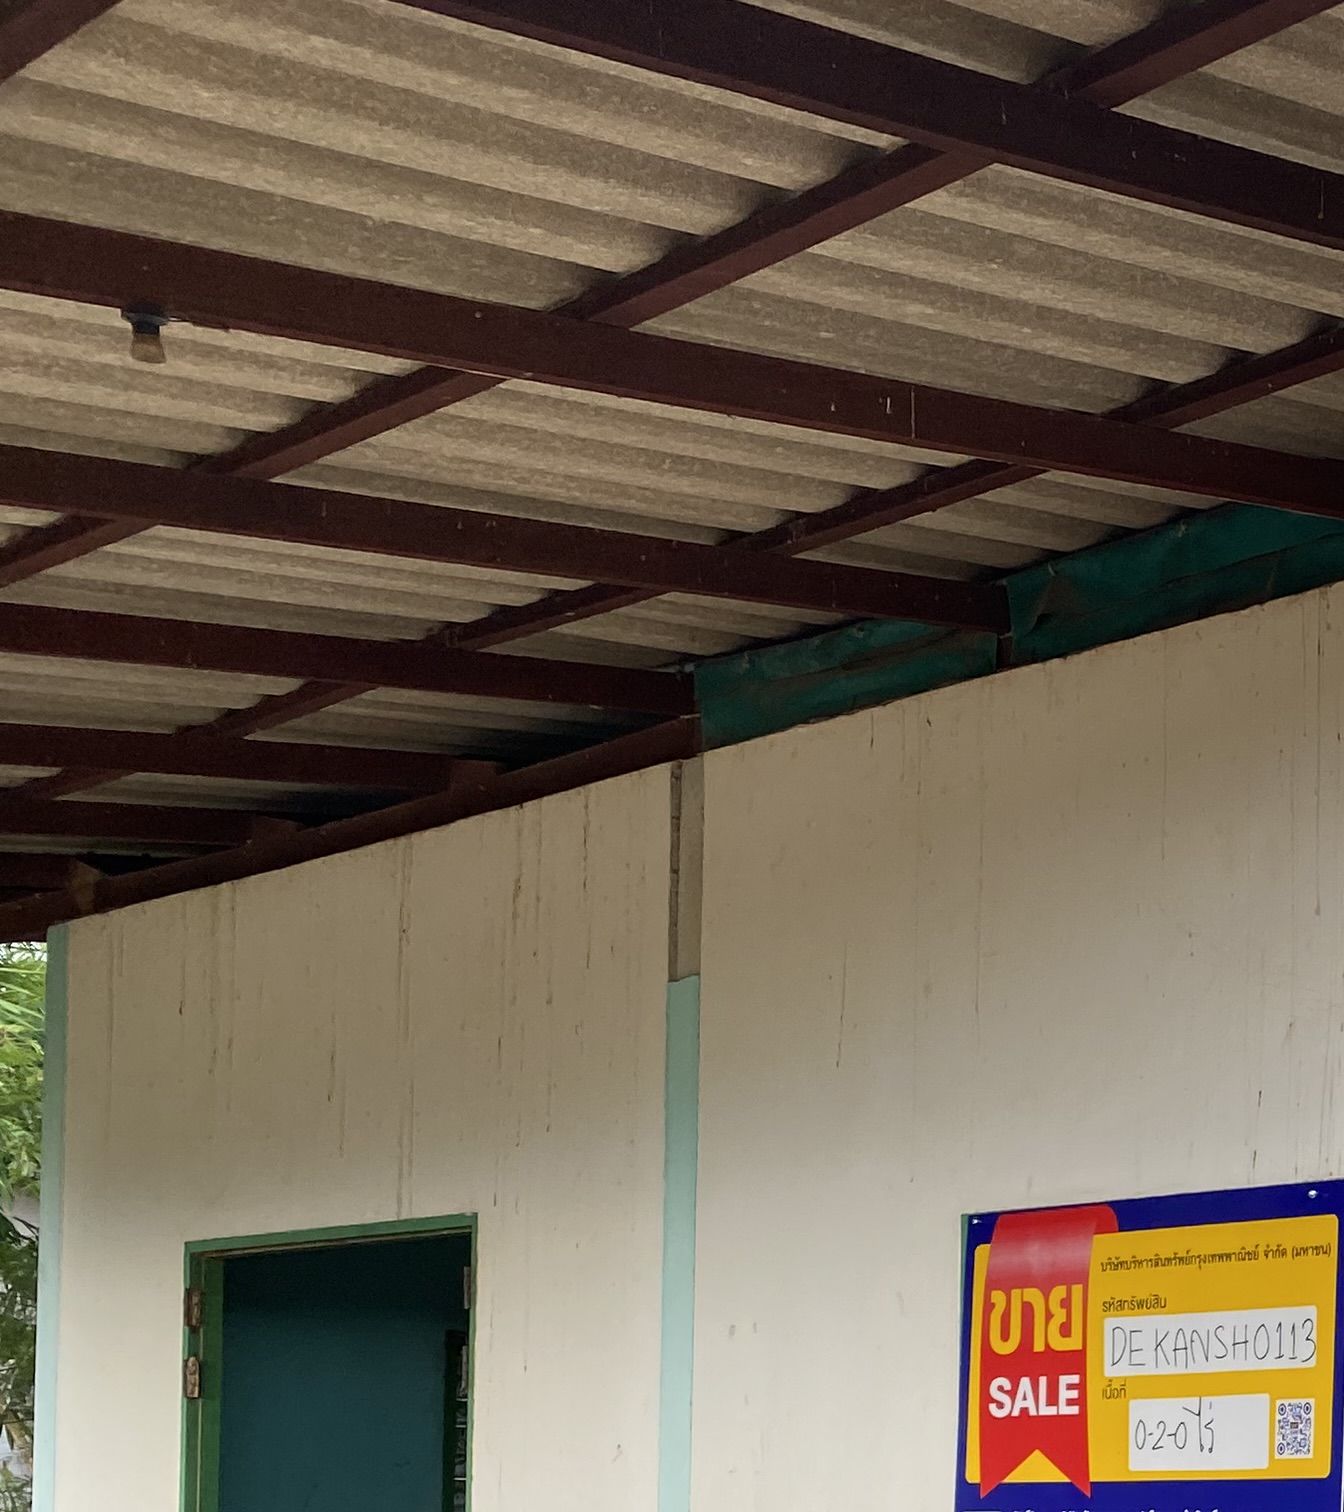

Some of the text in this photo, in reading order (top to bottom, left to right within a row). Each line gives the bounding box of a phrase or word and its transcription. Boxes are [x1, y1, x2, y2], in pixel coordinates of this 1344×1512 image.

[1263, 1243, 1288, 1260] จำกัด
[1291, 1242, 1332, 1261] (มหาชน)
[1101, 1294, 1168, 1314] รหัสทรัพย์สิน
[988, 1284, 1084, 1355] ขาย
[987, 1373, 1081, 1419] SALE
[1101, 1378, 1128, 1400] เนื้อที่
